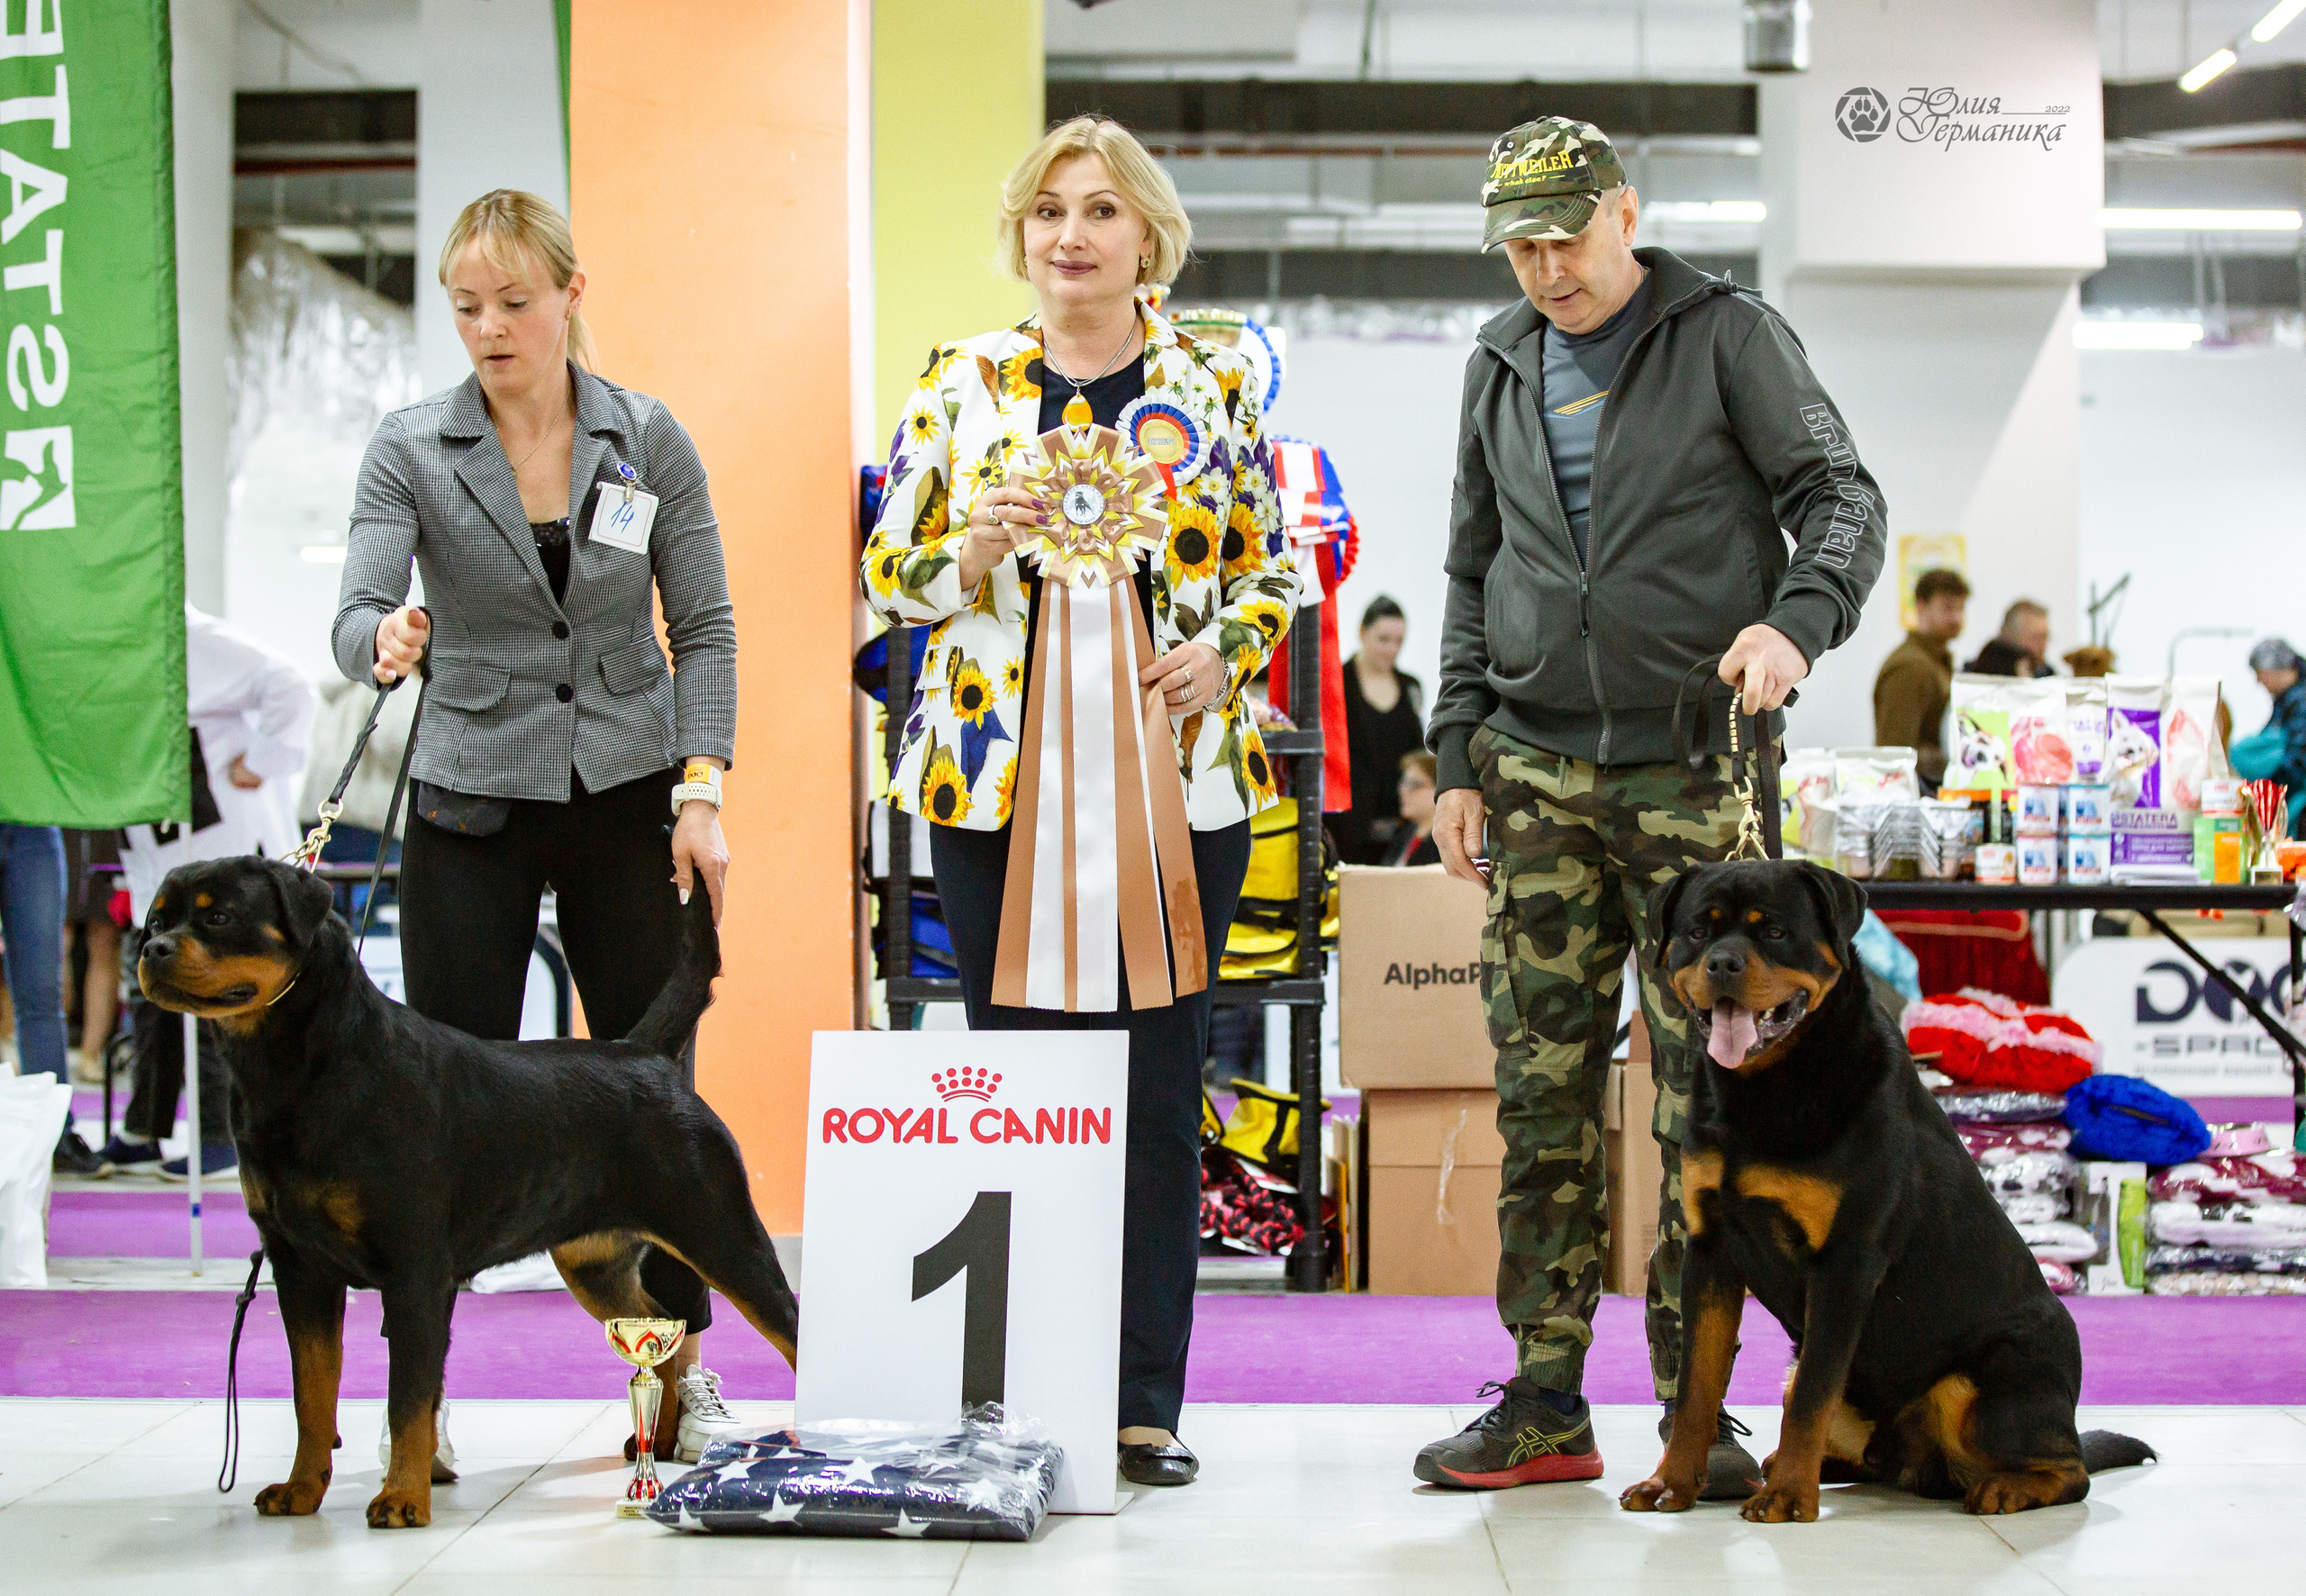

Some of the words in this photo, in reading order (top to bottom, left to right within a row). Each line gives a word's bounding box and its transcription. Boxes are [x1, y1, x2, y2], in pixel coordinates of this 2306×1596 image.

[1799, 403, 1860, 486] Brun
[611, 501, 634, 533] 14
[1384, 962, 1480, 990] AlphaP
[822, 1107, 958, 1145] ROYAL
[969, 1107, 1112, 1145] CANIN
[911, 1191, 1012, 1425] 1
